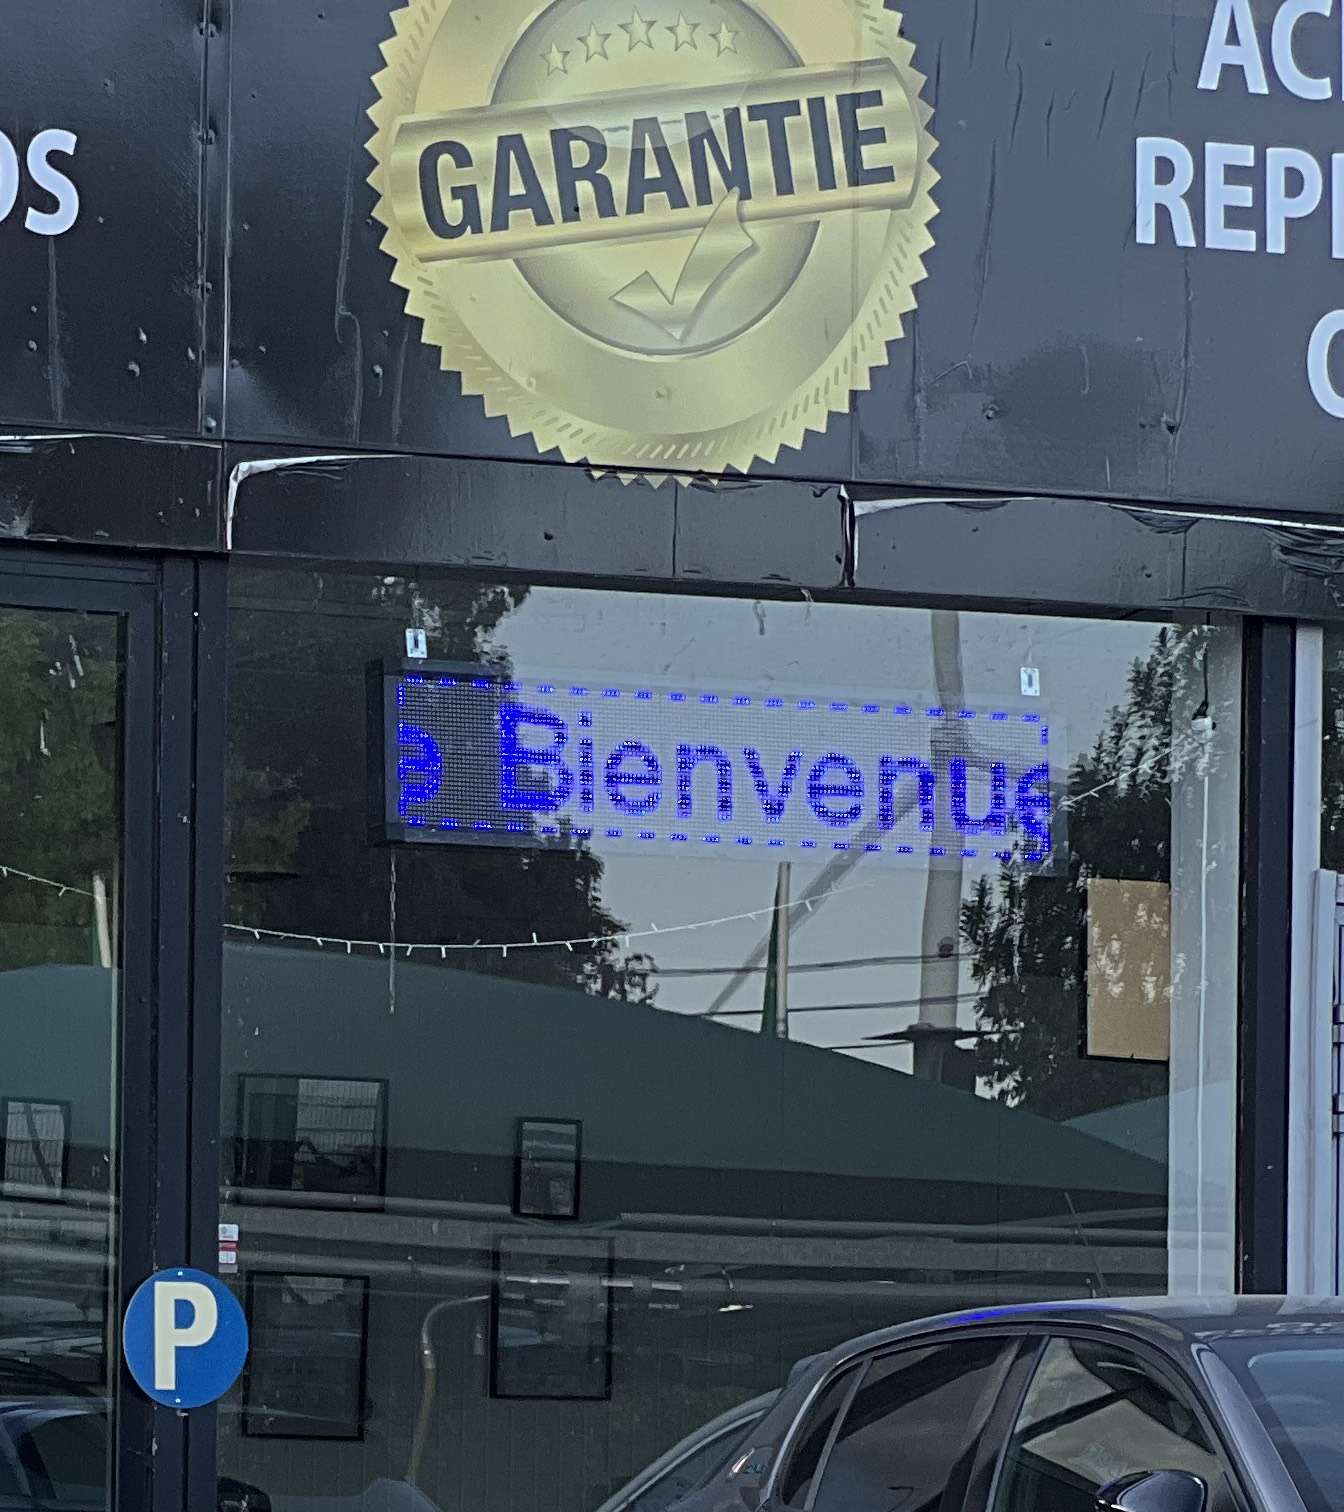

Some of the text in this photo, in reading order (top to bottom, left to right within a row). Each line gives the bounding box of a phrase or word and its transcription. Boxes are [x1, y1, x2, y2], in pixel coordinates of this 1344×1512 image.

[1196, 0, 1344, 100] AC
[417, 89, 896, 240] GARANTIE
[1134, 137, 1344, 260] REP
[154, 1280, 219, 1391] P
